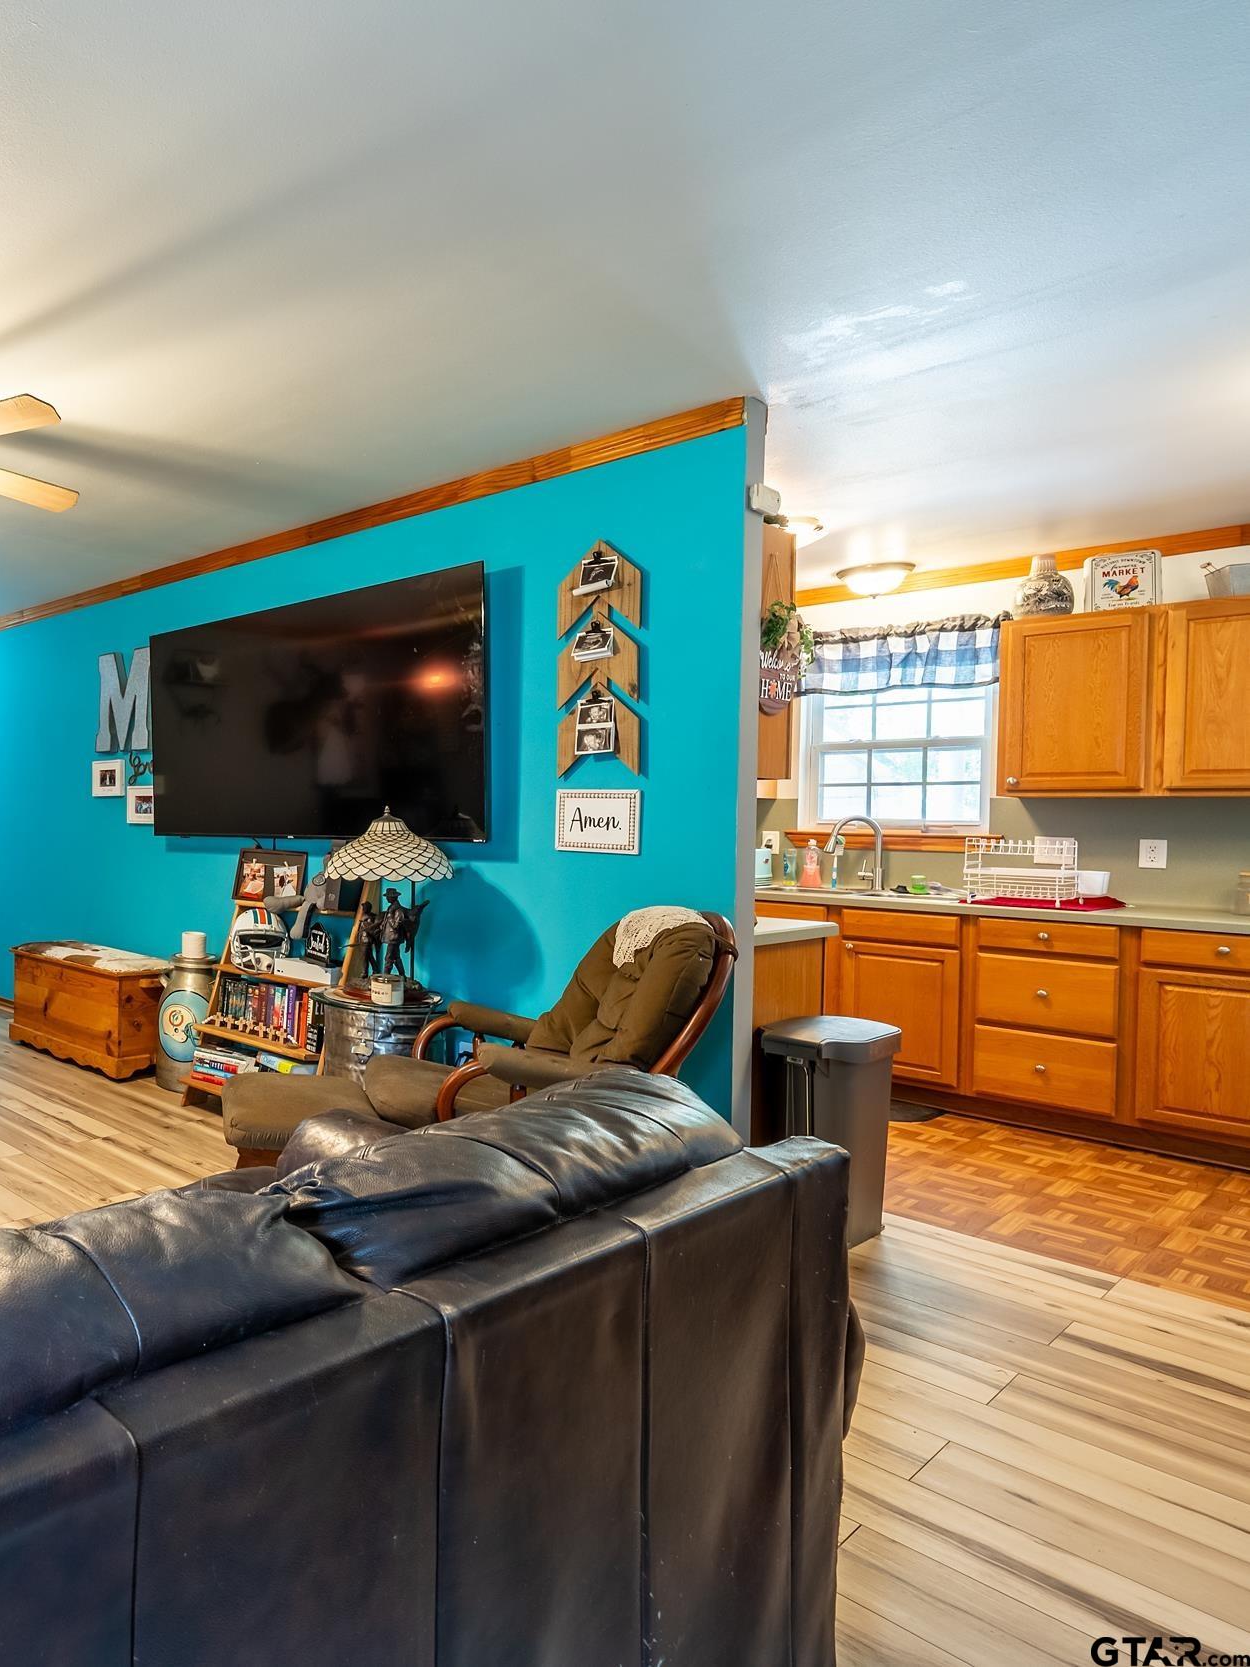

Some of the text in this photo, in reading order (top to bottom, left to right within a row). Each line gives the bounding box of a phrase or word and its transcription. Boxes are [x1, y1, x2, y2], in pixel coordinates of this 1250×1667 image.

[1102, 567, 1145, 577] MARKET
[95, 646, 151, 754] M
[569, 807, 622, 832] Amen.
